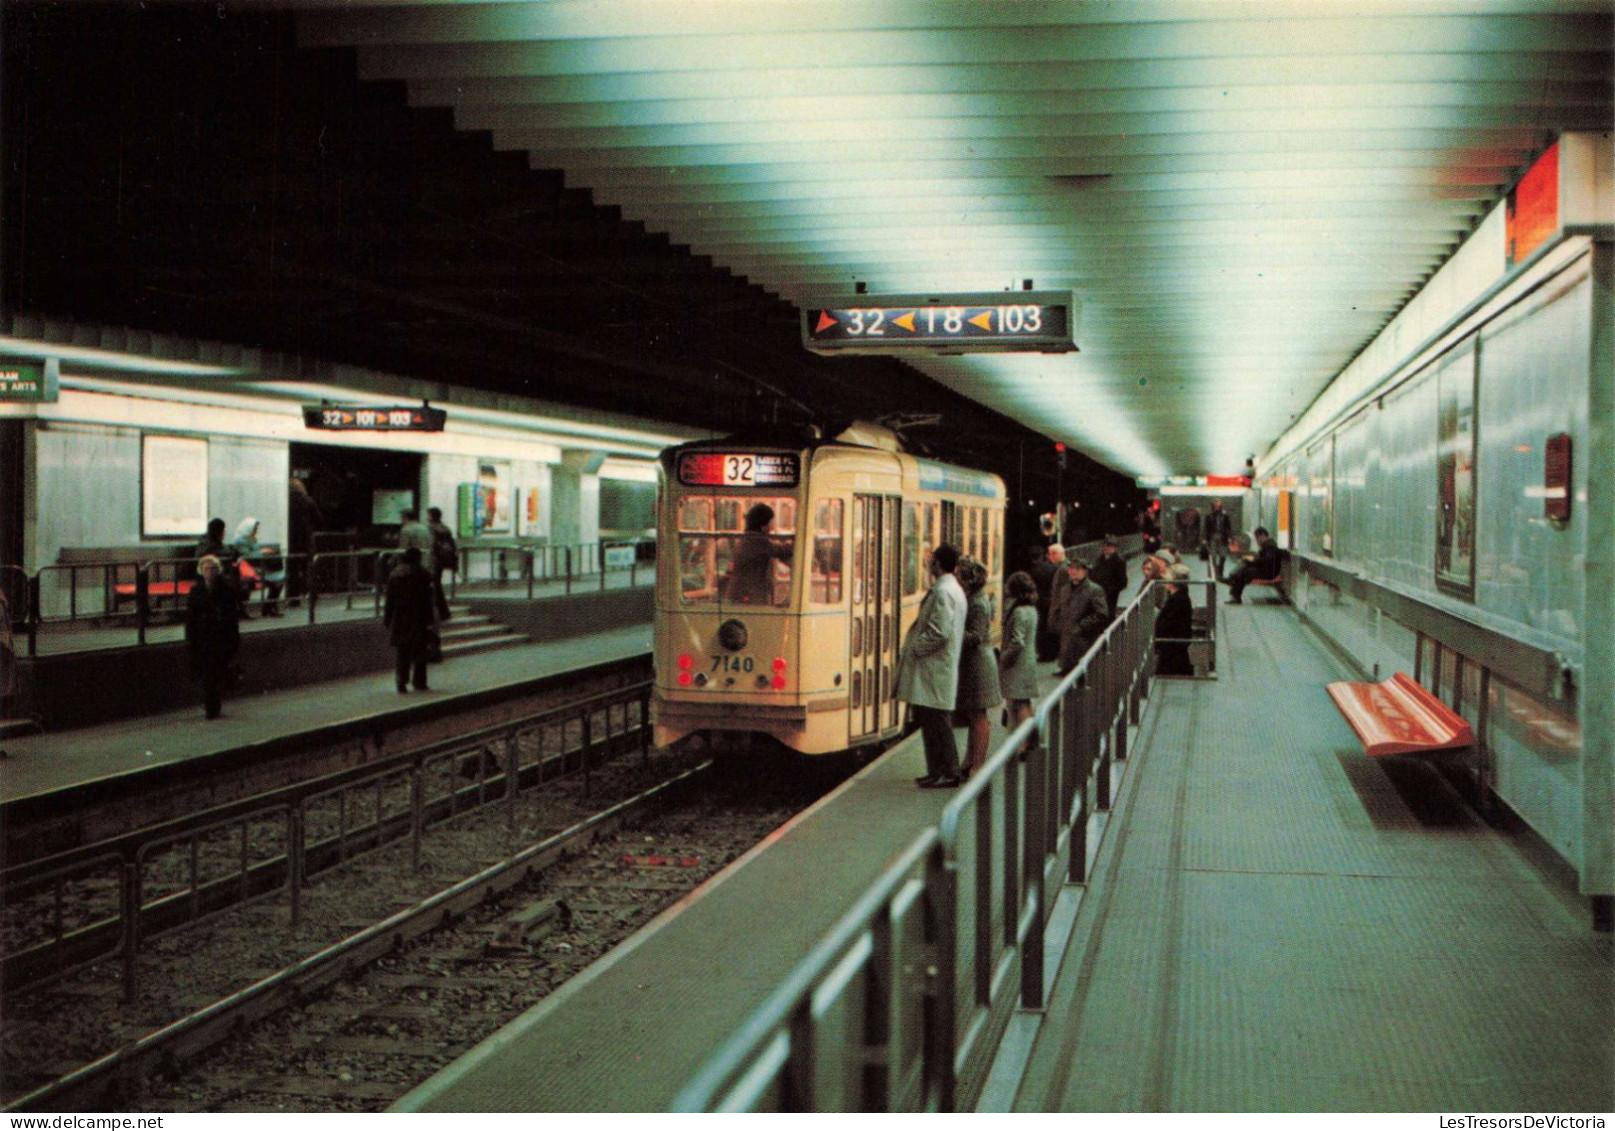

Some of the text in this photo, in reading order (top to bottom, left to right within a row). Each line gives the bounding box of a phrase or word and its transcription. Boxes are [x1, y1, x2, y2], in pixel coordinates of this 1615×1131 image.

[846, 308, 885, 336] 32
[997, 304, 1042, 333] 103
[322, 410, 342, 425] 32
[727, 456, 754, 481] 32
[711, 655, 754, 673] 7140
